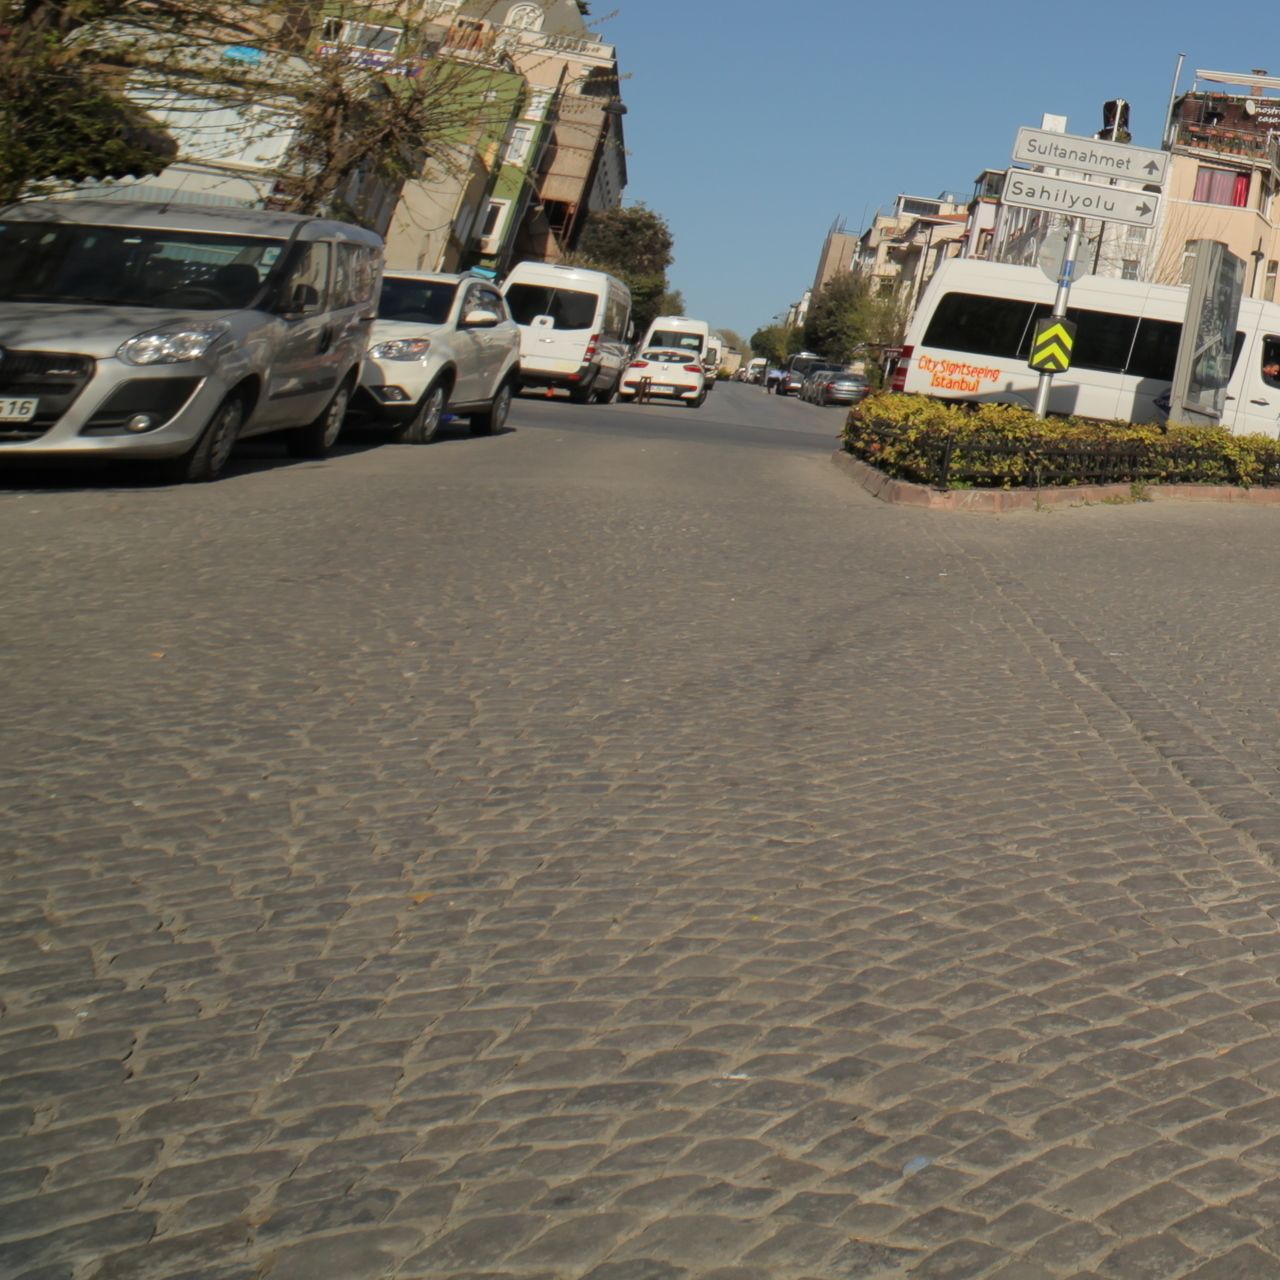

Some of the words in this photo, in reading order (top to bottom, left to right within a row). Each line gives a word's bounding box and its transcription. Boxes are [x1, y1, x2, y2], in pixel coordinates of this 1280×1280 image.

[1026, 138, 1132, 170] Sultanahmet
[1011, 180, 1116, 212] Sahilyolu
[918, 355, 939, 374] City
